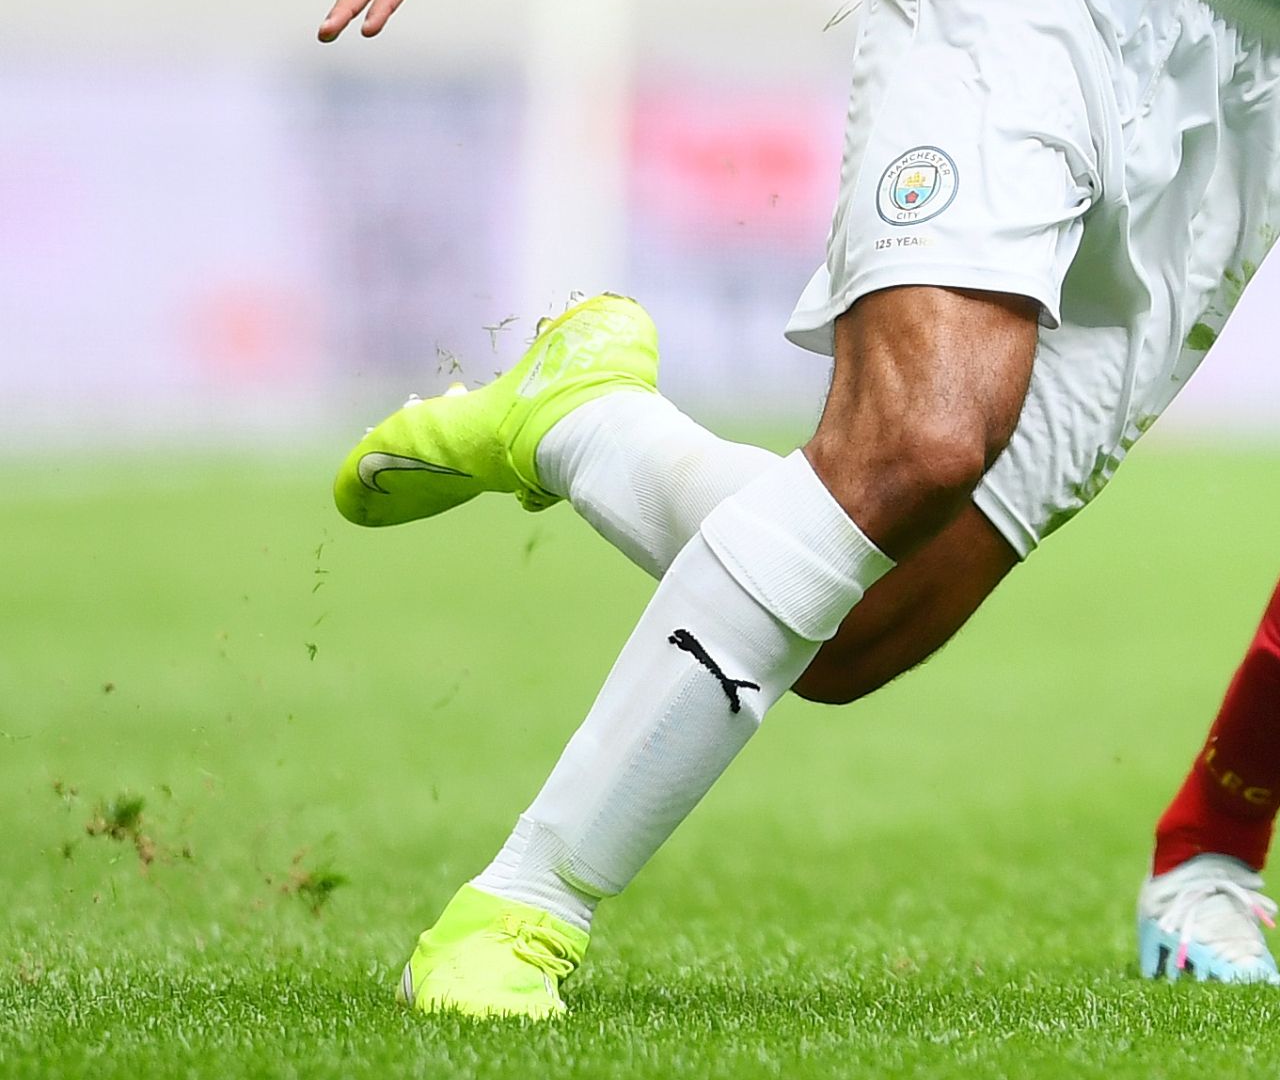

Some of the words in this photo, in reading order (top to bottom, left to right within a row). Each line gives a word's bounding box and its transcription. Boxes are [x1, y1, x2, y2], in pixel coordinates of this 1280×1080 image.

[887, 151, 951, 179] MANCHESTER
[896, 212, 920, 220] CITY
[875, 238, 893, 250] 125
